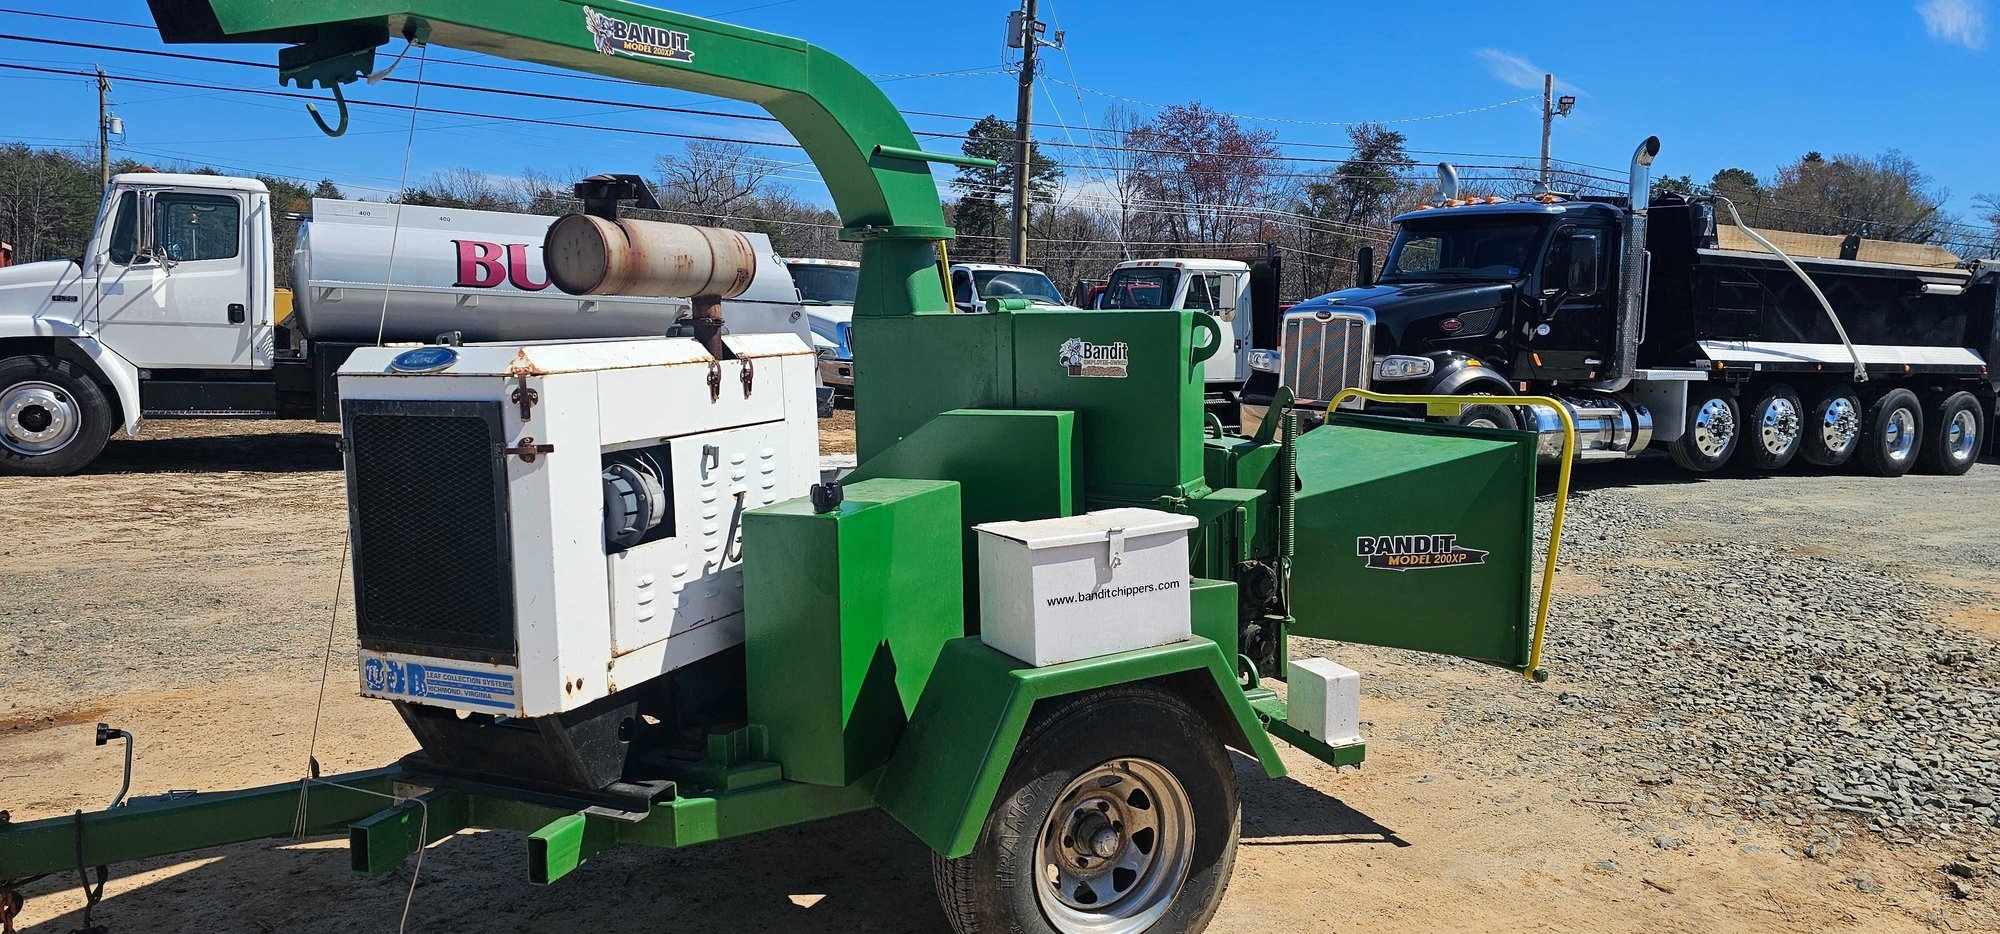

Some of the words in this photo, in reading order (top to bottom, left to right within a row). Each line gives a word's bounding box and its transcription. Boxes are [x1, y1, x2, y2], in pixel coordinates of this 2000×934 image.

[613, 20, 688, 51] BANDIT
[623, 41, 652, 54] MODEL
[653, 47, 675, 57] 200XP
[1083, 342, 1128, 360] Bandit
[1358, 535, 1456, 555] BANDIT
[1388, 554, 1431, 565] MODEL
[1434, 553, 1467, 564] 200XP
[1046, 579, 1180, 607] www.banditchippers.com
[426, 671, 442, 680] LEAF
[442, 674, 482, 686] COLLECTION
[482, 679, 514, 689] SYSTEMS
[427, 685, 463, 696] RICHMOND,
[464, 689, 492, 700] VIRGINIA
